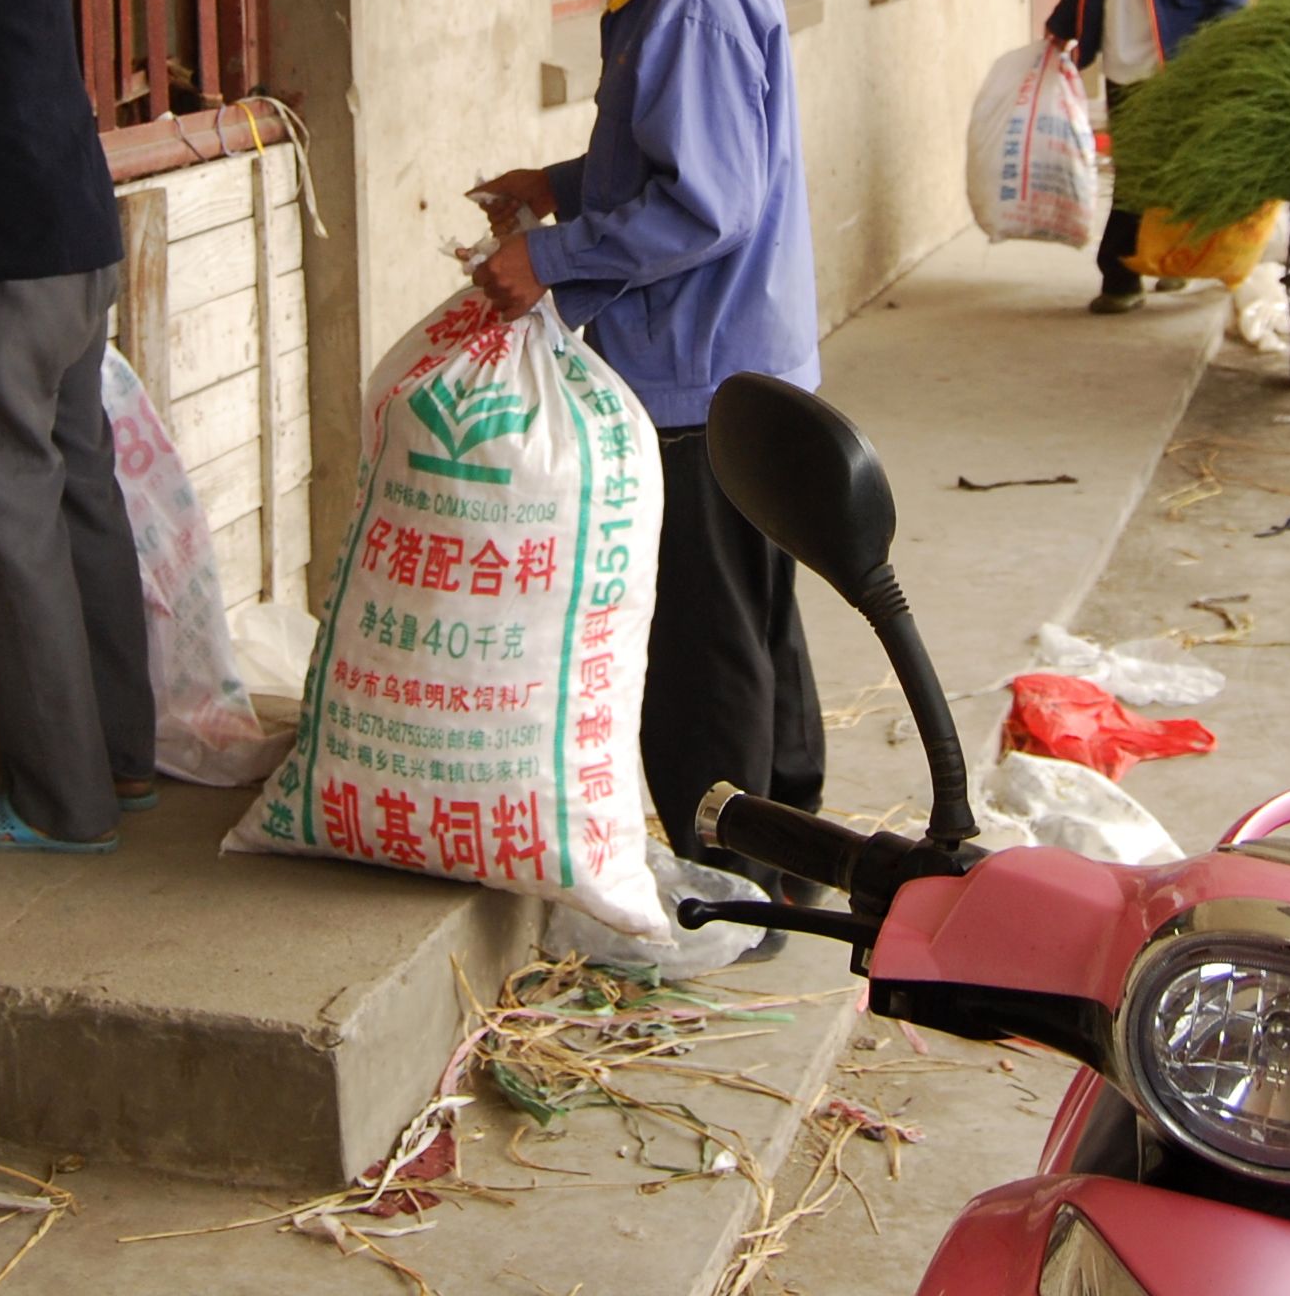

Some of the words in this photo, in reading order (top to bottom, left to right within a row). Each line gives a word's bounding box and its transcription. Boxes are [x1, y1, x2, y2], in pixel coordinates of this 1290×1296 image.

[361, 517, 558, 597] 仔猪配合料
[359, 601, 526, 661] 净含量40千克
[321, 776, 547, 881] 凯基饲料
